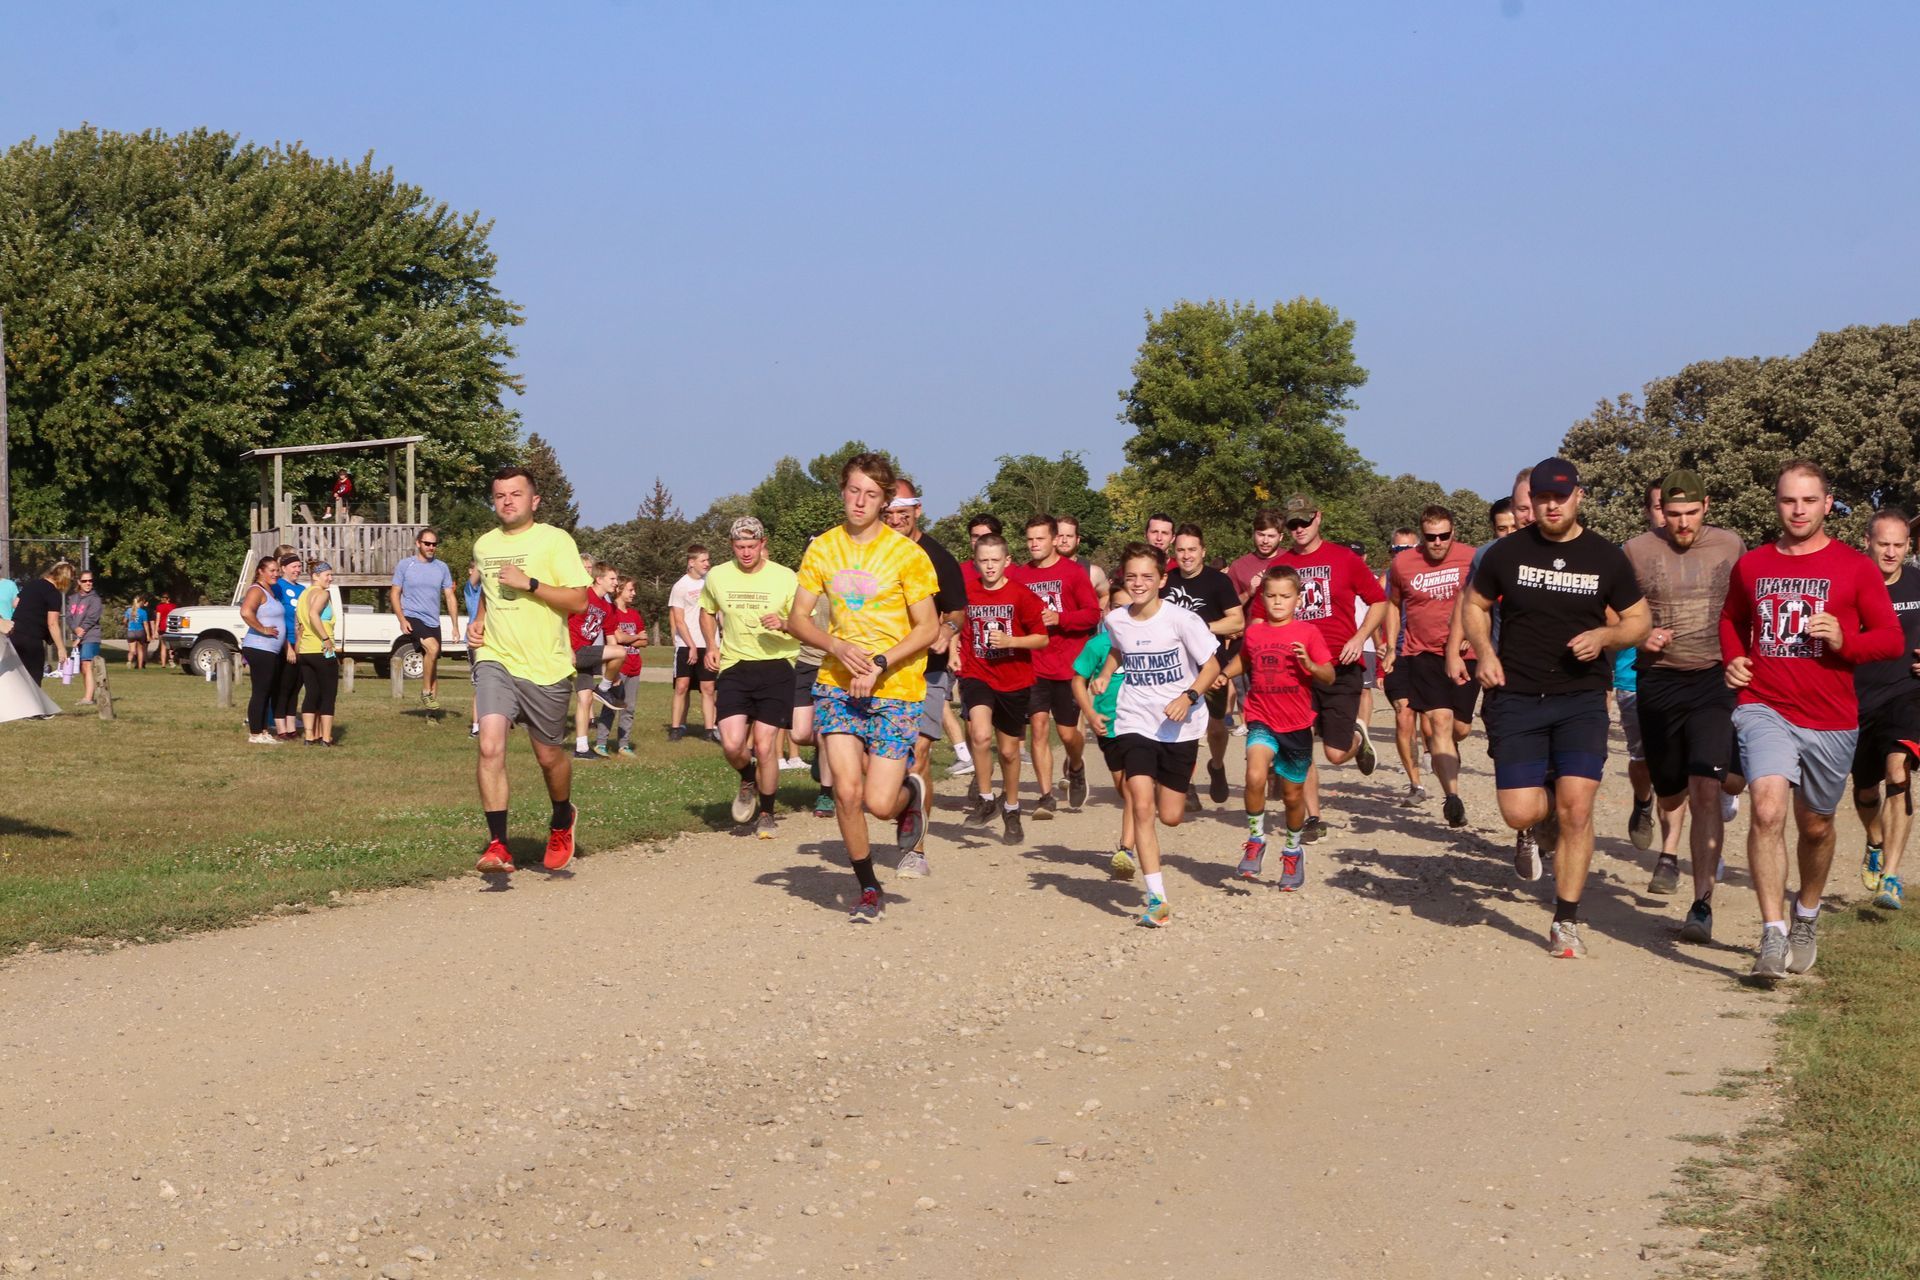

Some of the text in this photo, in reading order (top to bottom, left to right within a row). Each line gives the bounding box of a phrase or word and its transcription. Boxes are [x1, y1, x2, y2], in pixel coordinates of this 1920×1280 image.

[1297, 565, 1331, 580] RRIOR
[1410, 572, 1460, 591] CANNABIS
[1518, 565, 1600, 590] DEFENDERS
[1517, 579, 1598, 596] DORDT UNIVERSITY
[1756, 577, 1831, 602] WARRIOR
[967, 604, 1014, 620] WARRIOR
[1148, 650, 1180, 669] MARTY
[1759, 643, 1813, 658] YEARS
